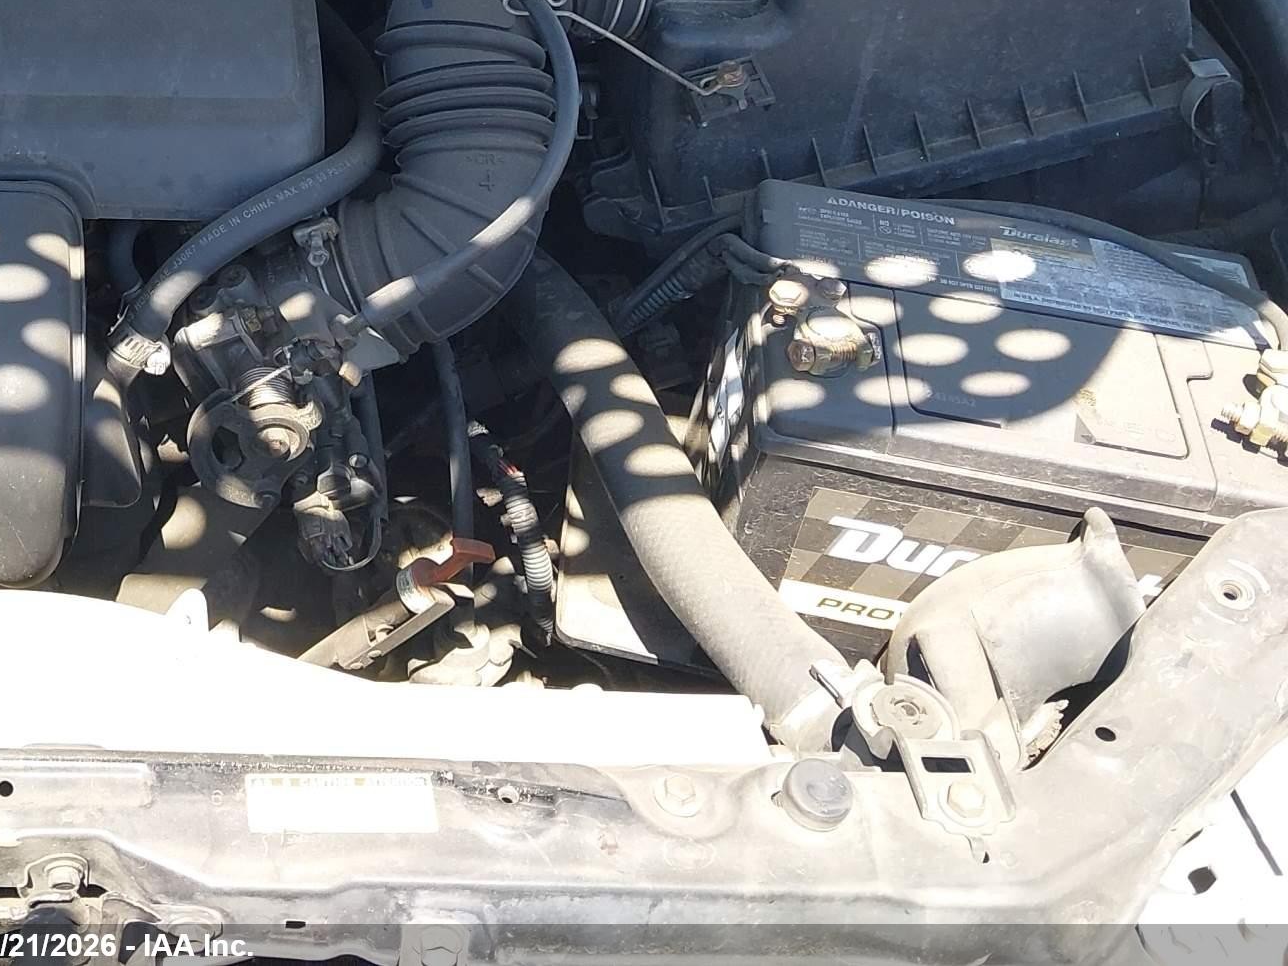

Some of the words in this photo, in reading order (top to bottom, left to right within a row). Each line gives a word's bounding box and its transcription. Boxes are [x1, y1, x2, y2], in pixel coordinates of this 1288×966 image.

[199, 225, 227, 246] MADE
[228, 214, 242, 228] IN
[242, 197, 275, 220] CHINA
[836, 197, 956, 226] DANGER/POISON
[999, 225, 1079, 249] Duralast
